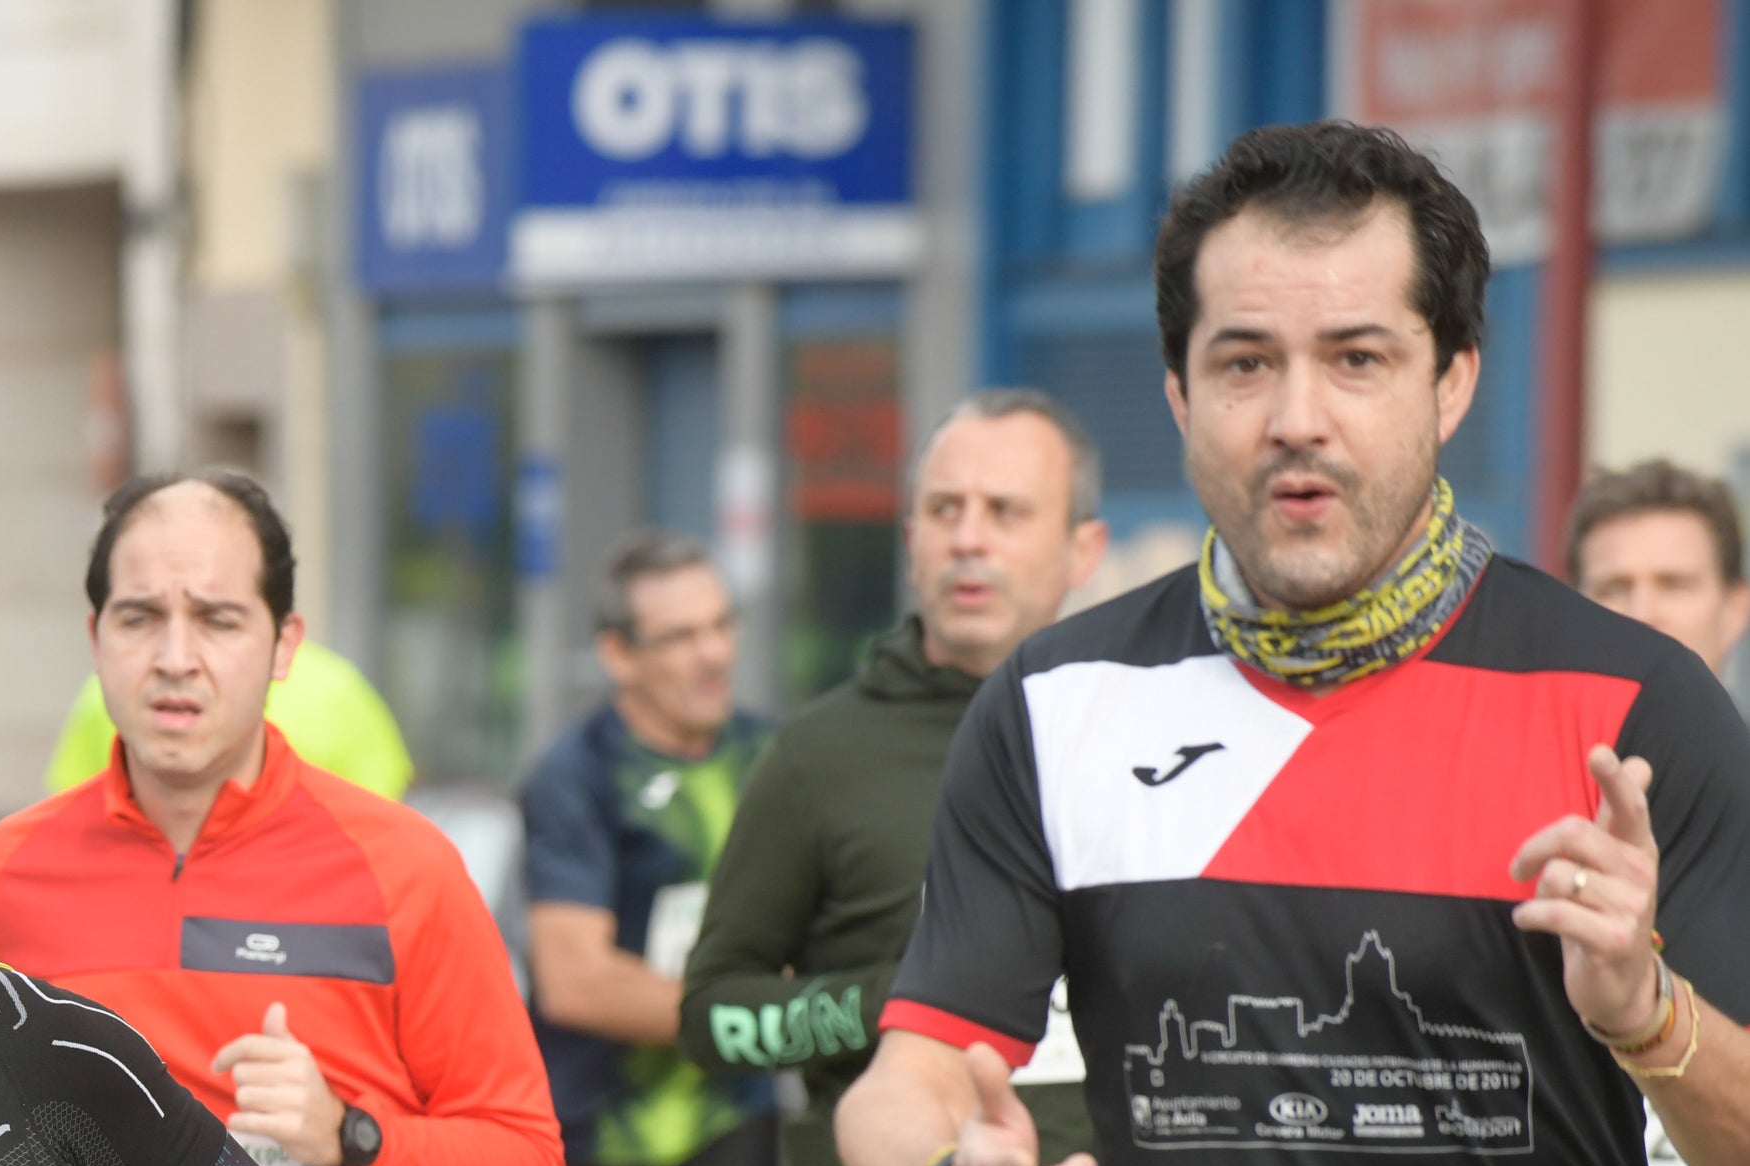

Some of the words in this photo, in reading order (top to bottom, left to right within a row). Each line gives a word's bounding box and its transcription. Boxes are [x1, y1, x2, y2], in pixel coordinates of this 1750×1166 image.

[572, 36, 869, 161] OTIS
[709, 985, 867, 1066] RUN
[1330, 1069, 1352, 1087] 20
[1354, 1069, 1377, 1087] DE
[1379, 1069, 1453, 1090] OCTUBRE
[1456, 1072, 1479, 1090] DE
